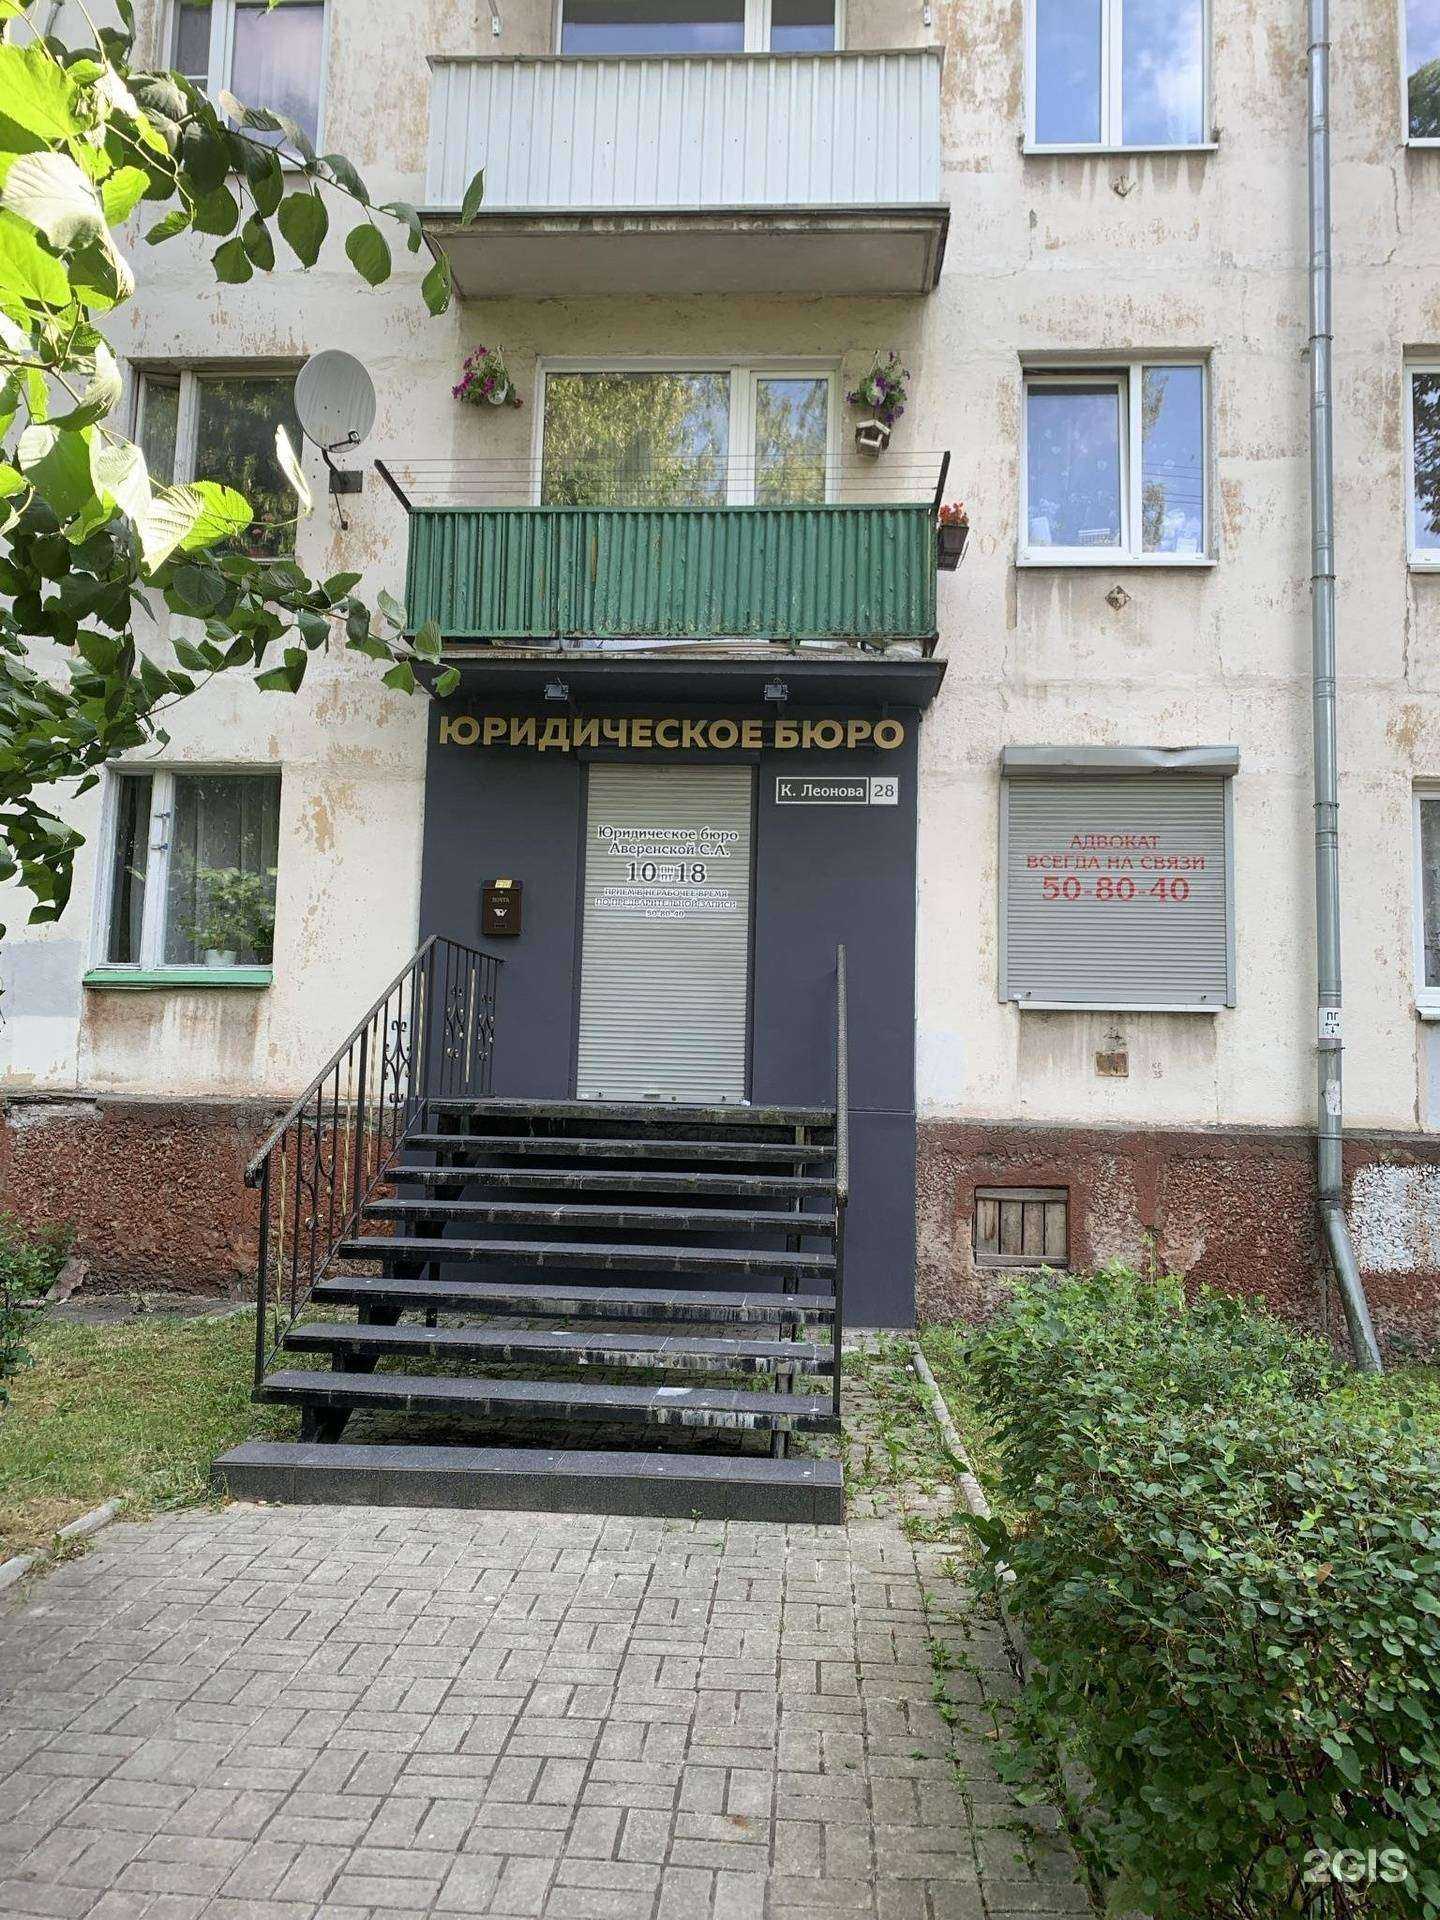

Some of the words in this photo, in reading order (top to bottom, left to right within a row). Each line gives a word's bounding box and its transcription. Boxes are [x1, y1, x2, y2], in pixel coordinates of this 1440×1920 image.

[439, 716, 763, 752] ЮРИДИЧЕСКОЕ
[775, 719, 905, 749] БЮРО
[780, 784, 796, 797] К.
[801, 784, 864, 797] Леонова
[874, 785, 895, 797] 28
[598, 826, 696, 841] Юридическое
[700, 827, 739, 842] бюро
[1069, 834, 1160, 850] АДВОКАТ
[609, 842, 695, 857] Аверенской
[699, 844, 730, 856] С.А.
[1027, 855, 1100, 870] ВСЕГДА
[1107, 856, 1134, 870] НА
[1140, 856, 1205, 870] СВЯЗИ
[626, 861, 657, 882] 10
[677, 862, 706, 883] 18
[1042, 876, 1190, 903] 50-80-40
[1326, 1011, 1339, 1021] ПГ
